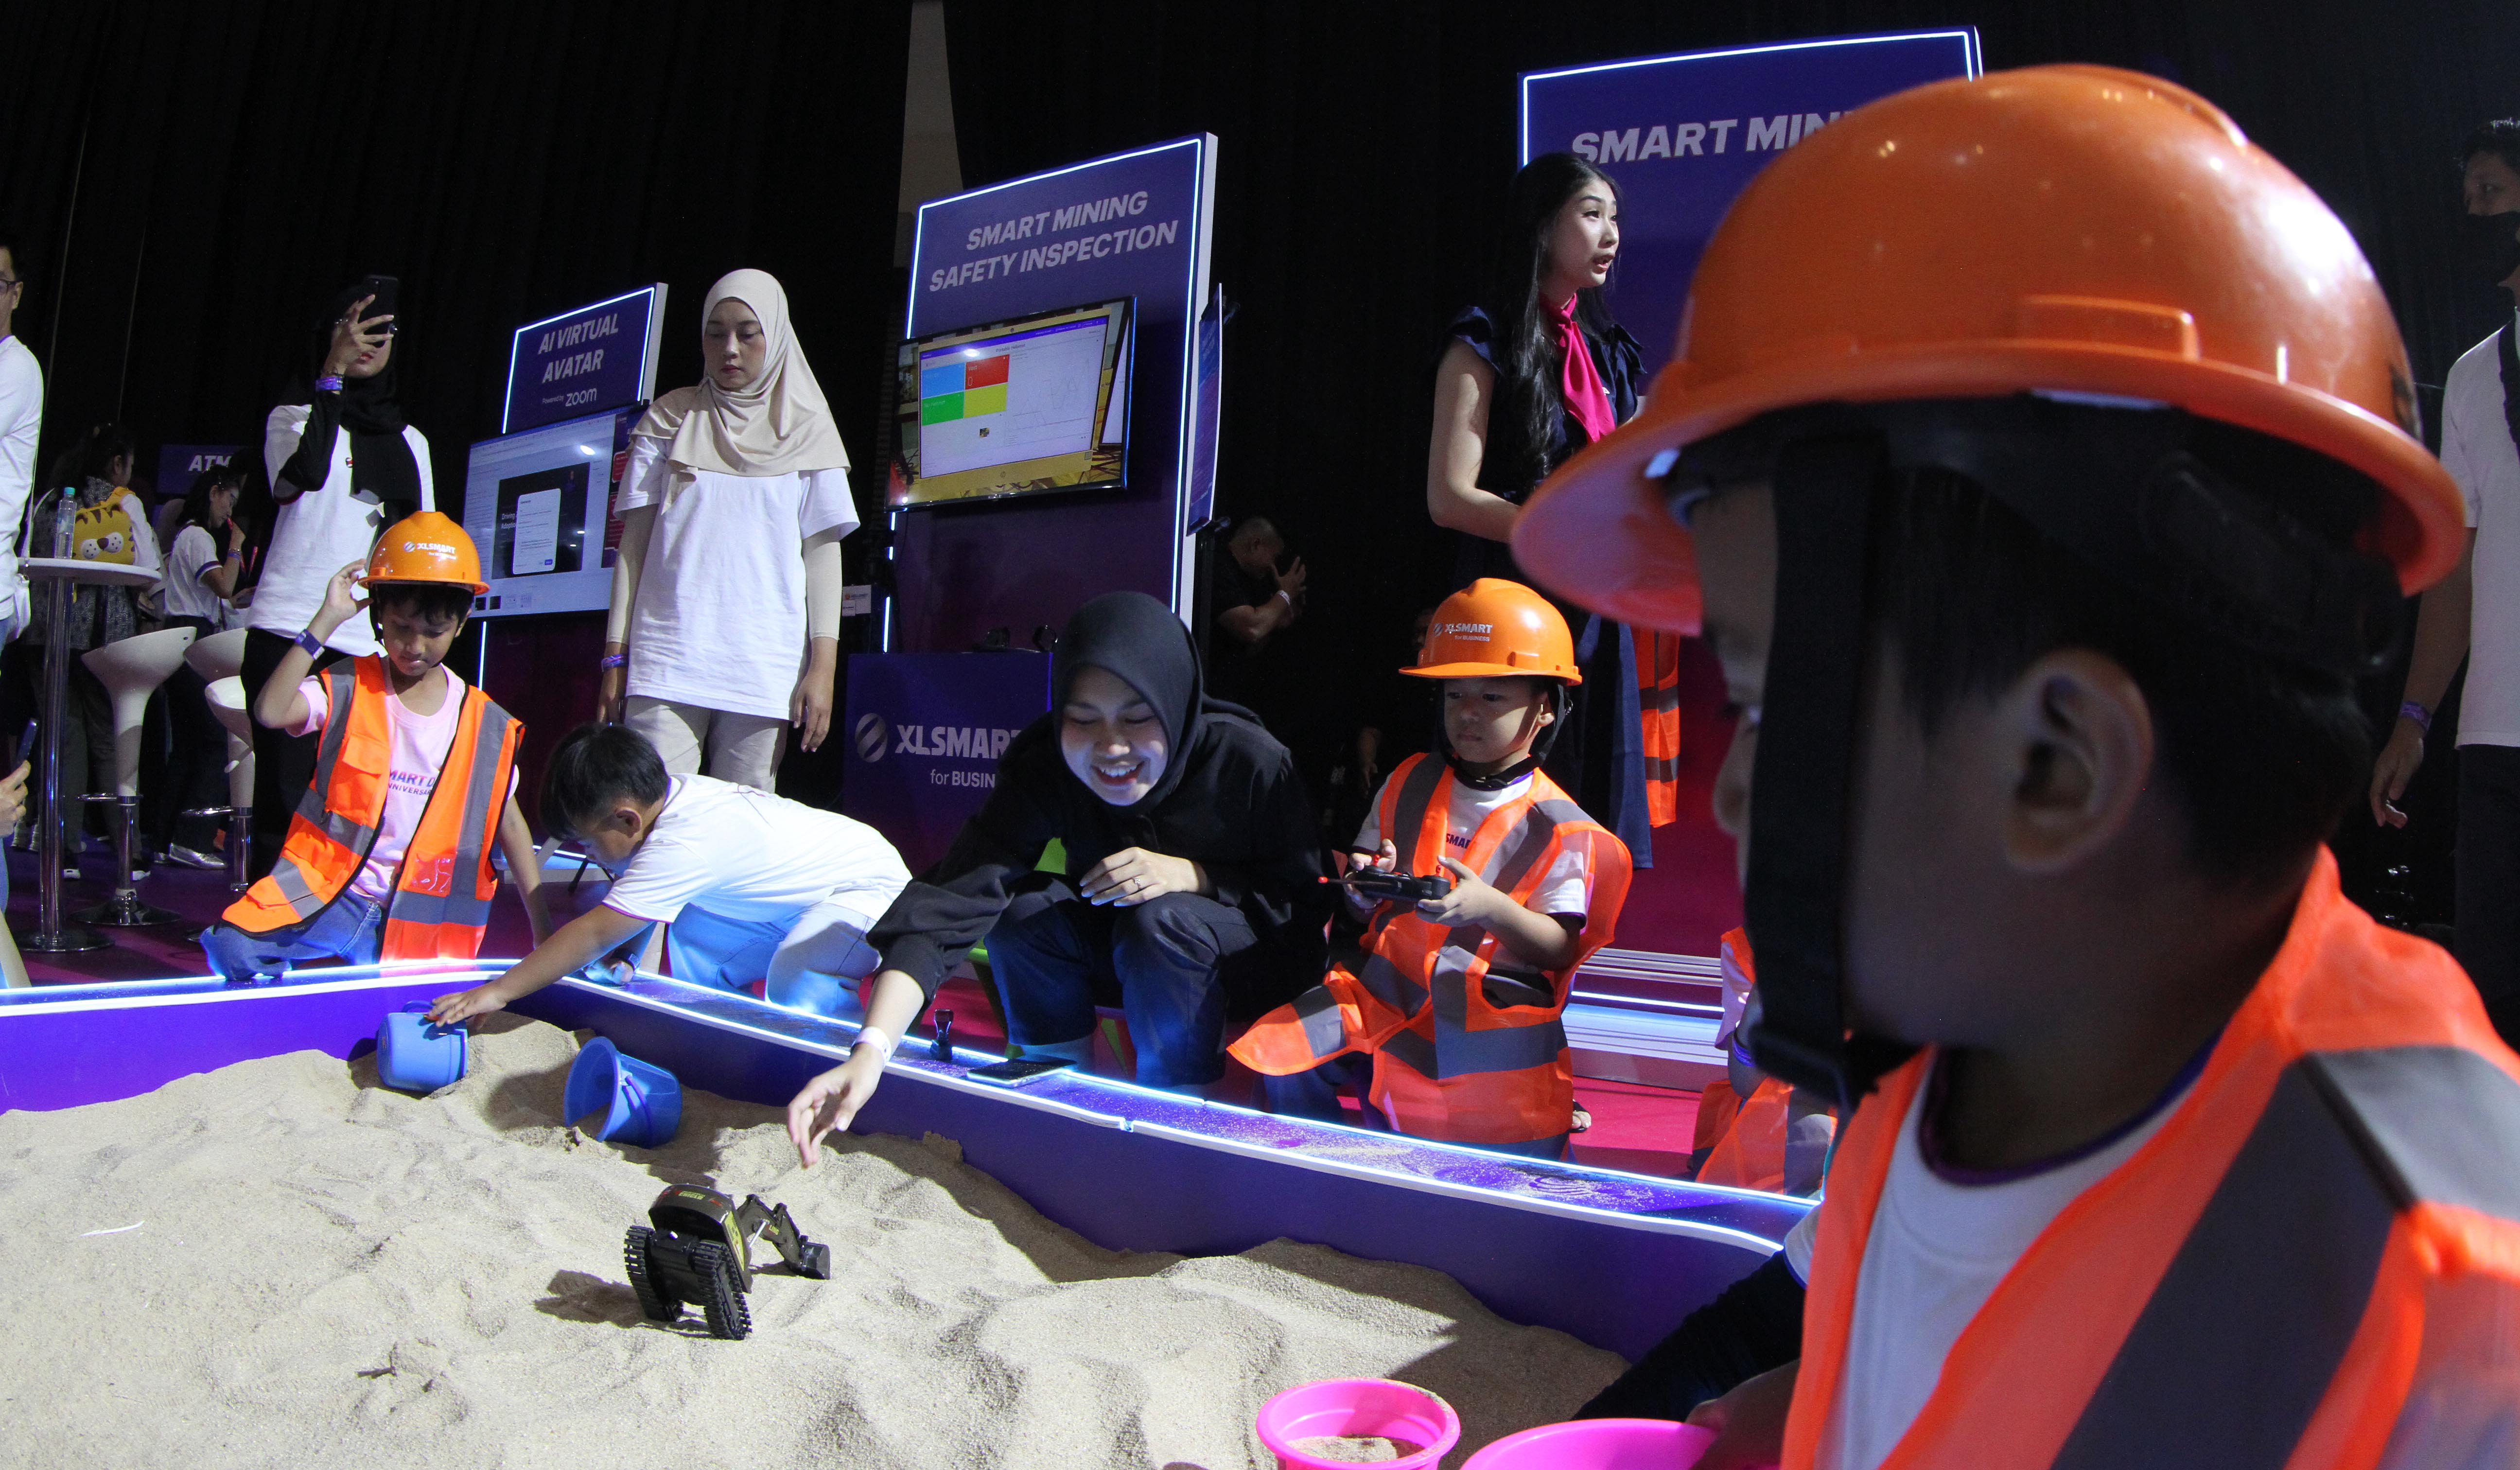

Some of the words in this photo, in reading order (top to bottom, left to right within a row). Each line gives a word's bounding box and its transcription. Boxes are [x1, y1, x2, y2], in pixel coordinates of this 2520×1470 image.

[1572, 119, 1738, 164] SMART
[1746, 111, 1854, 152] MIN
[966, 212, 1050, 250] SMART
[1052, 191, 1148, 232] MINING
[929, 252, 1018, 292] SAFETY
[1019, 220, 1178, 273] INSPECTION
[537, 331, 556, 355] AI
[557, 313, 618, 350] VIRTUAL
[542, 349, 604, 384] AVATAR
[565, 388, 597, 406] zoom
[417, 543, 455, 553] XLSMART
[1445, 623, 1493, 633] XLSMART
[894, 724, 1022, 759] XLSMAR
[930, 769, 949, 785] for
